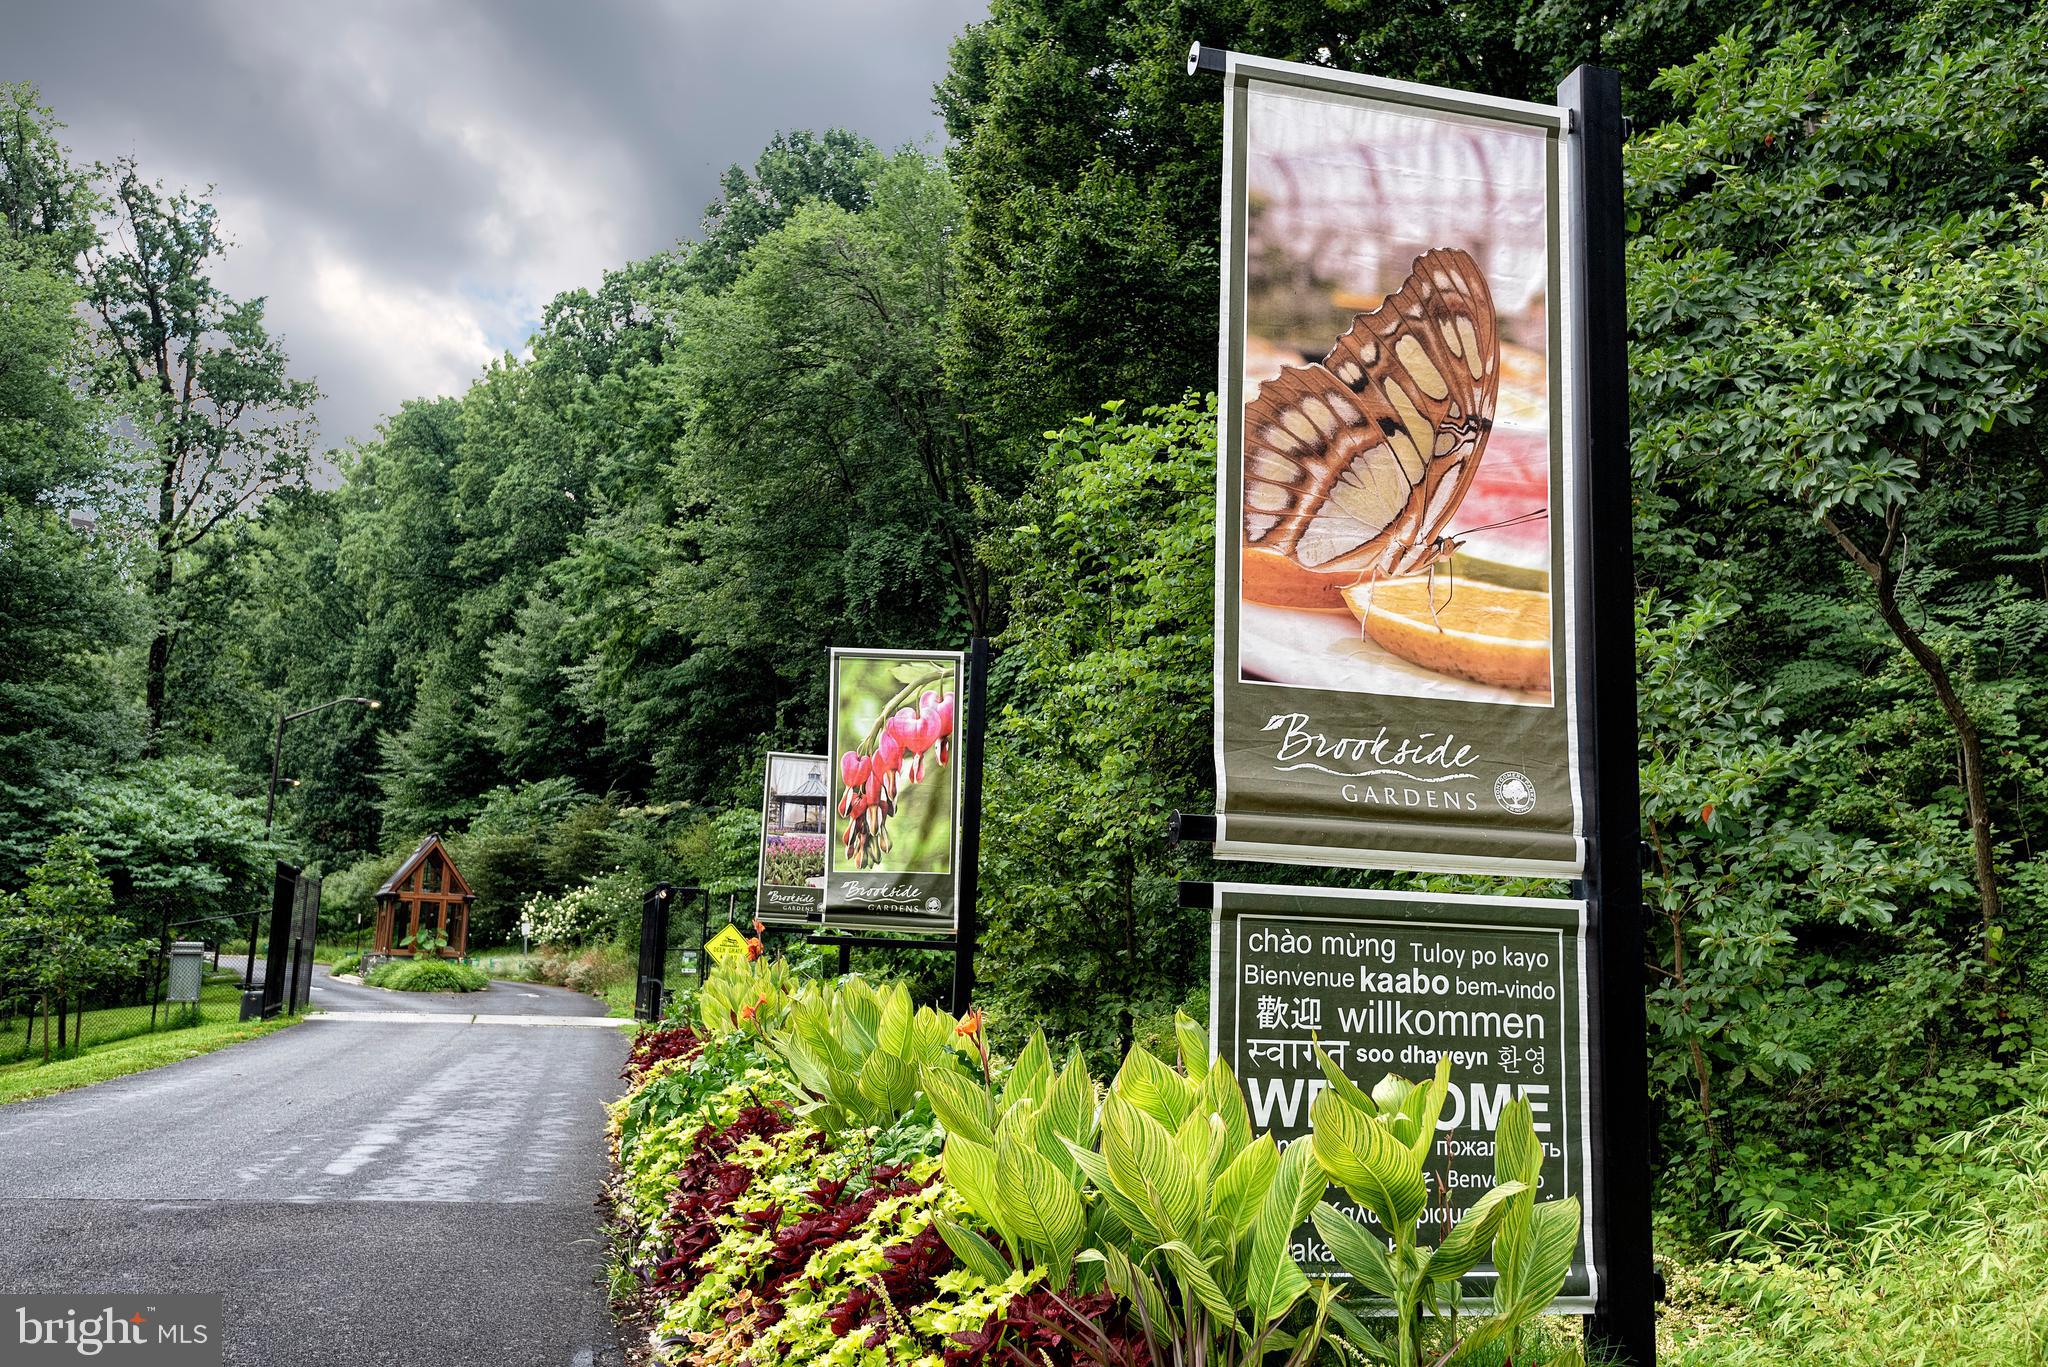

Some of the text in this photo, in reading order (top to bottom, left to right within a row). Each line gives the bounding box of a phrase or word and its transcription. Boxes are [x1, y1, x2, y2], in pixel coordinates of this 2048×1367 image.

[1275, 712, 1481, 769] Brookside
[1341, 783, 1478, 811] GARDENS
[770, 890, 816, 902] Brookside
[846, 880, 922, 899] Brookside
[866, 903, 920, 914] GARDENS
[1248, 927, 1549, 972] chào mừng Tuloy po kayo
[1244, 964, 1556, 1000] Bienvenue kaabo bem-vindo
[1256, 994, 1322, 1030] 歡迎
[1337, 999, 1545, 1039] willkommen
[1246, 1038, 1350, 1070] स्वागत
[1356, 1043, 1489, 1071] soo dhaweyn
[1497, 1044, 1545, 1075] 환영
[1247, 1078, 1551, 1133] WOME
